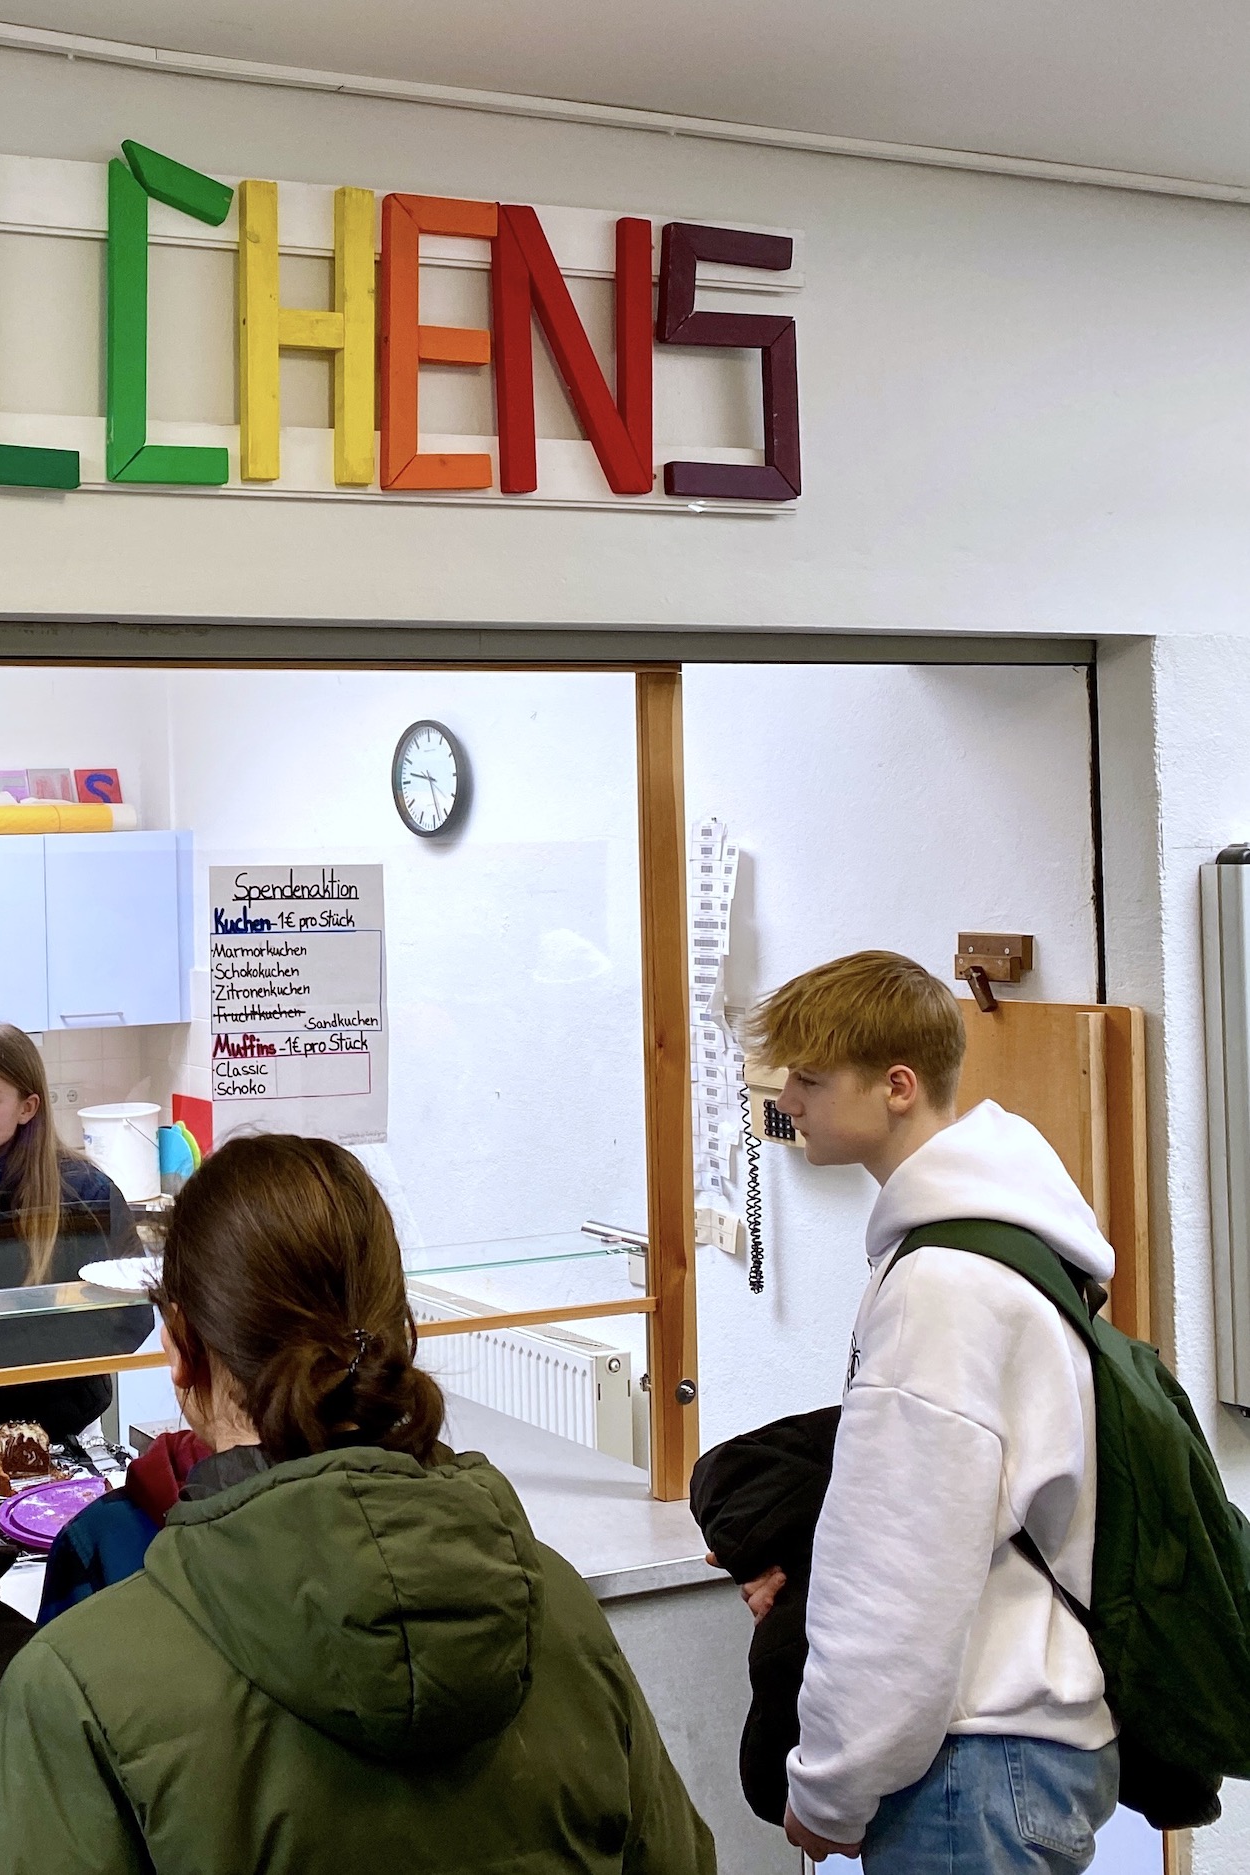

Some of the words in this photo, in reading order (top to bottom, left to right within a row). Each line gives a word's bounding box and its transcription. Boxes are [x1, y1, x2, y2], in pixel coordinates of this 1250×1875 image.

[232, 868, 359, 908] Spendenaktion
[214, 906, 271, 934] Kuchen
[212, 940, 307, 959] Marmorkuchen
[214, 962, 299, 980] Schokokuchen
[215, 980, 310, 1001] Zitronenkuchen
[307, 1010, 379, 1030] Sandkuchen
[212, 1032, 277, 1057] Muffins
[303, 1041, 326, 1058] pro
[329, 1031, 368, 1051] Stück
[215, 1061, 269, 1078] Classic
[217, 1079, 266, 1096] Schoko
